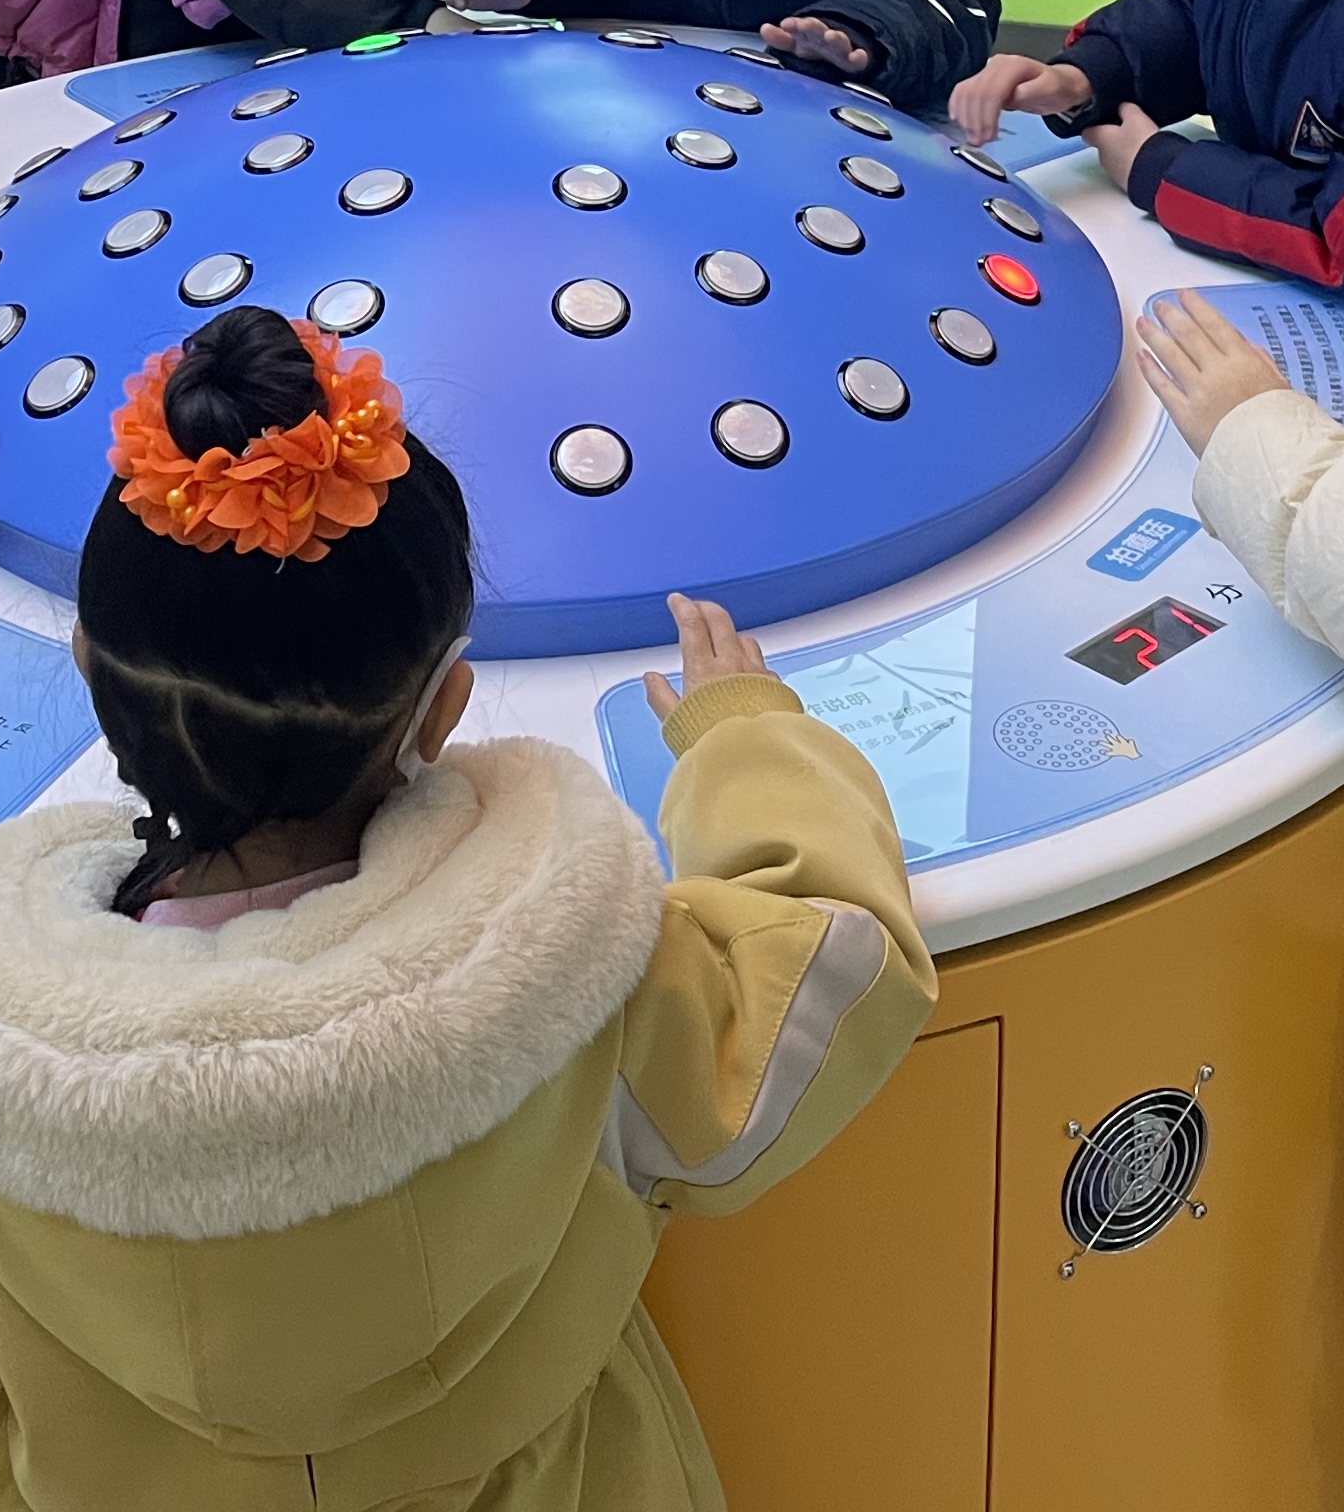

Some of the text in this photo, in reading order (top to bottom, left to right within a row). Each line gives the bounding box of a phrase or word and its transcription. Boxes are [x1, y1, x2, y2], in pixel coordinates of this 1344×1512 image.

[1105, 518, 1176, 568] 拍蘑菇
[1205, 582, 1244, 605] 分
[1112, 606, 1214, 671] 21
